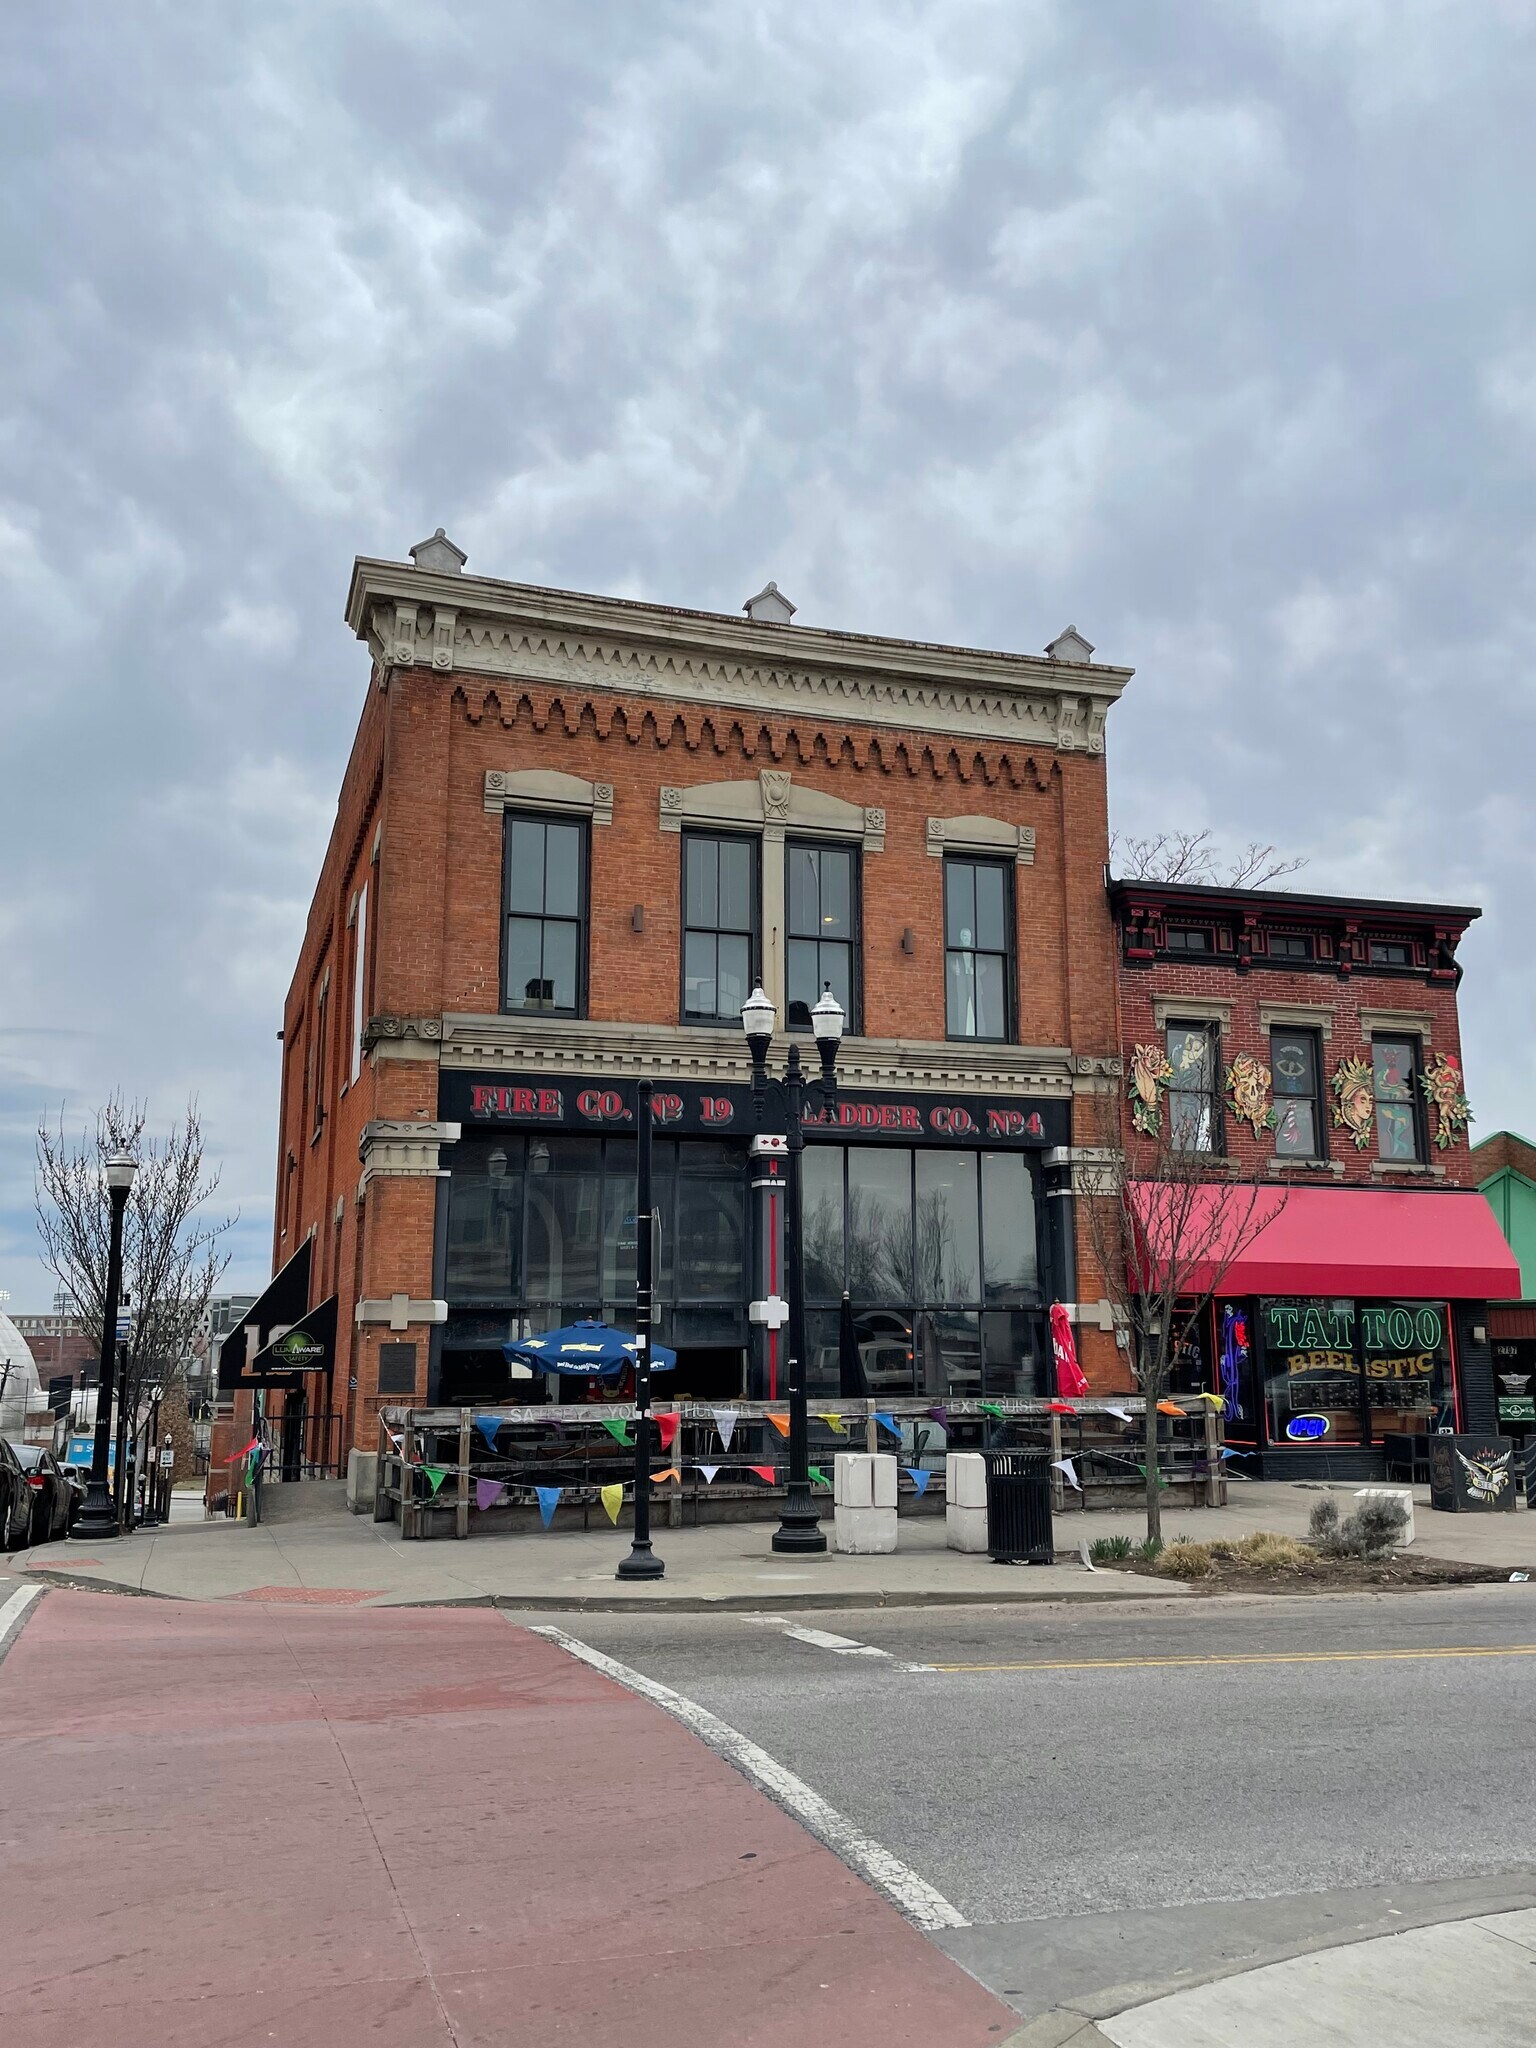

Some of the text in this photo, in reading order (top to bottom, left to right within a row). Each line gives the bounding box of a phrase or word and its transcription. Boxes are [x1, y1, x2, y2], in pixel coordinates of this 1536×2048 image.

[470, 1085, 563, 1120] FIRE
[699, 1096, 735, 1127] 19
[800, 1101, 924, 1135] LADDER
[929, 1106, 980, 1136] CO.
[1270, 1308, 1442, 1350] TATTOO
[1288, 1419, 1326, 1436] OPEN
